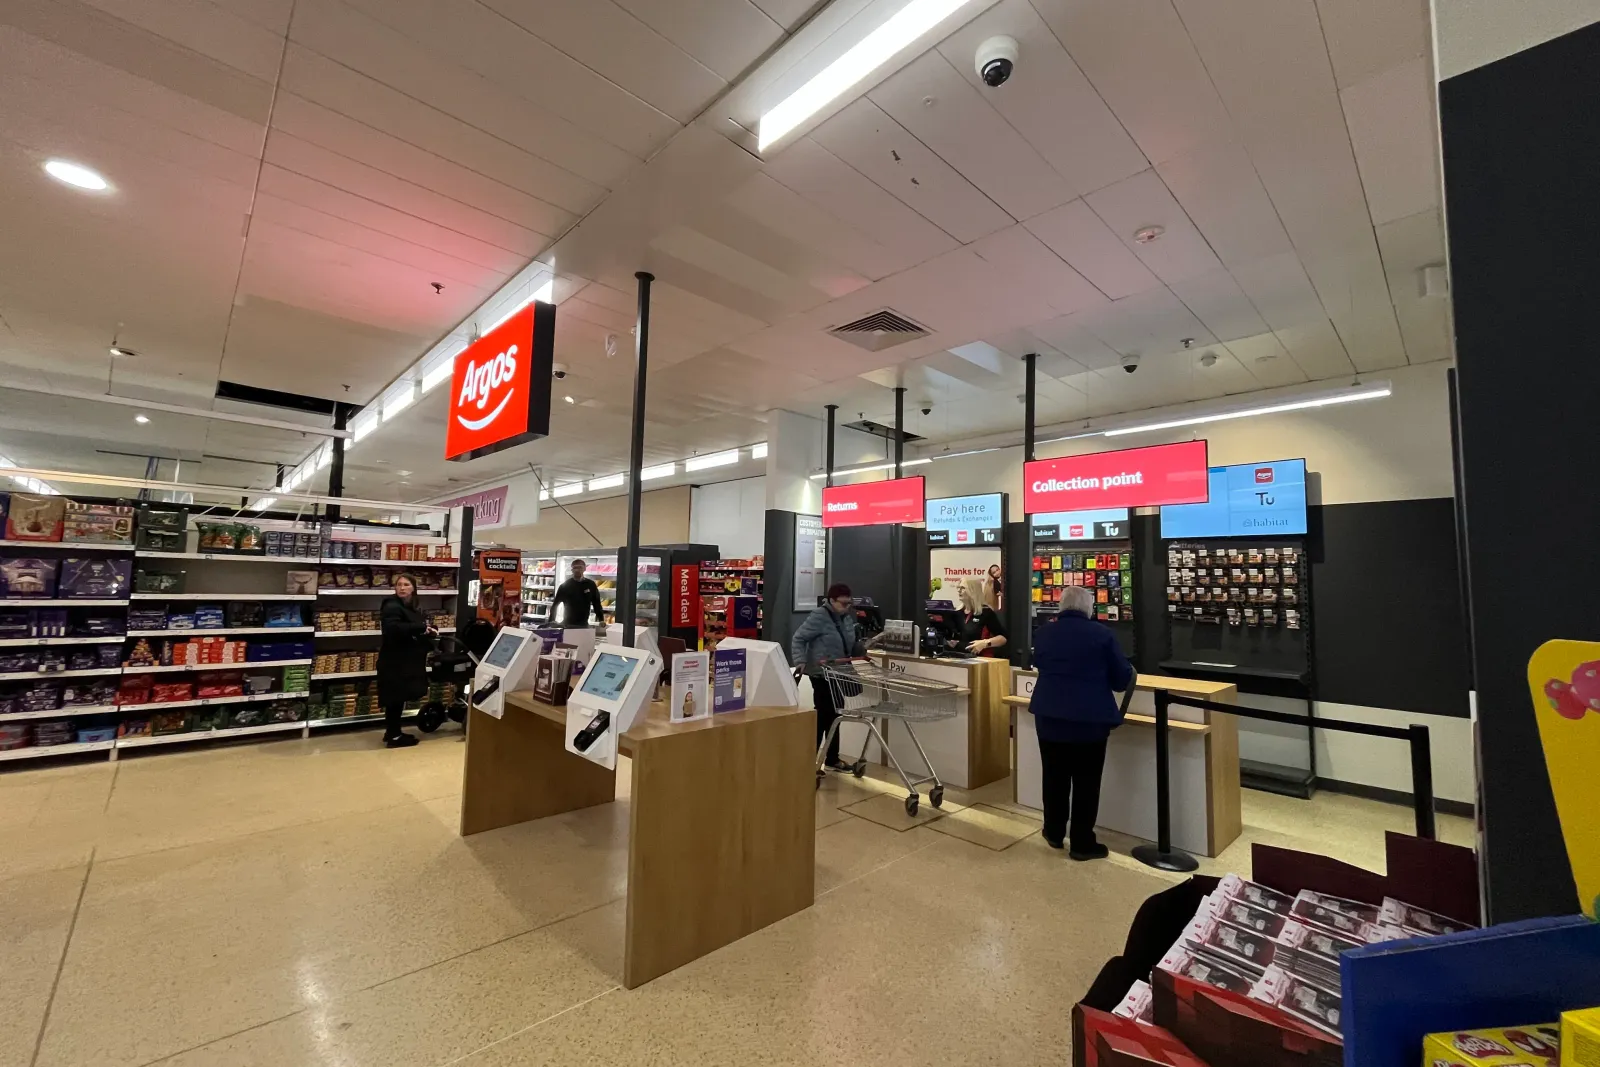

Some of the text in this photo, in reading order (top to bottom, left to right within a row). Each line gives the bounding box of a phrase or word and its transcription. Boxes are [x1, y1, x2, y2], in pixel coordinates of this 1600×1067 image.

[458, 344, 518, 409] Argos
[1032, 471, 1143, 493] Collection point
[1255, 492, 1275, 505] Tu
[827, 502, 858, 511] Returns
[940, 504, 986, 516] Pay here
[1253, 518, 1289, 527] habitat
[981, 529, 995, 541] Tu
[1102, 522, 1119, 537] Tu
[944, 568, 985, 576] Thanks for
[681, 568, 690, 623] Meal deal
[890, 662, 906, 673] Pay
